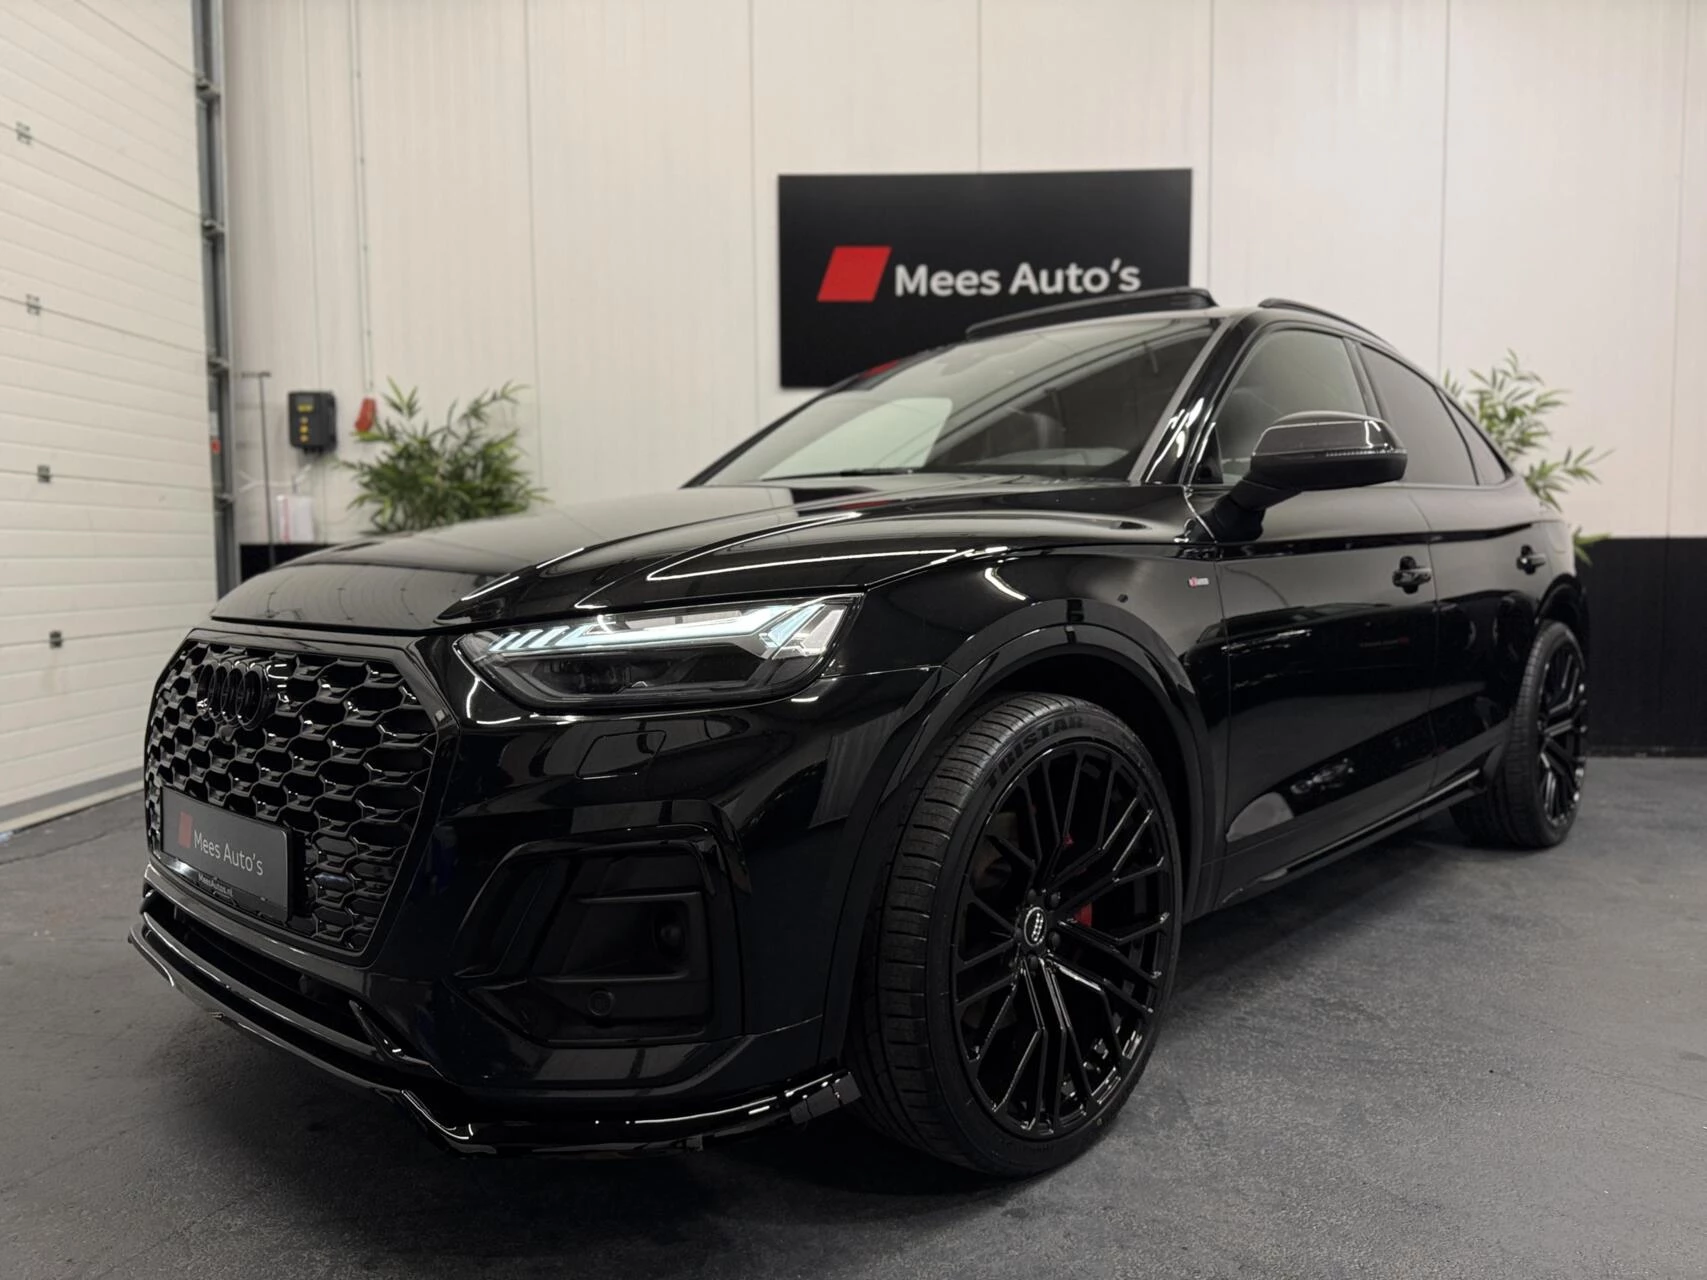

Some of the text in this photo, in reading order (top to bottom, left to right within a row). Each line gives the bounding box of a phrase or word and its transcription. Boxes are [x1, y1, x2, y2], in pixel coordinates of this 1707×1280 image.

[894, 258, 1141, 297] Mees Auto's
[194, 831, 264, 876] Mees Auto's
